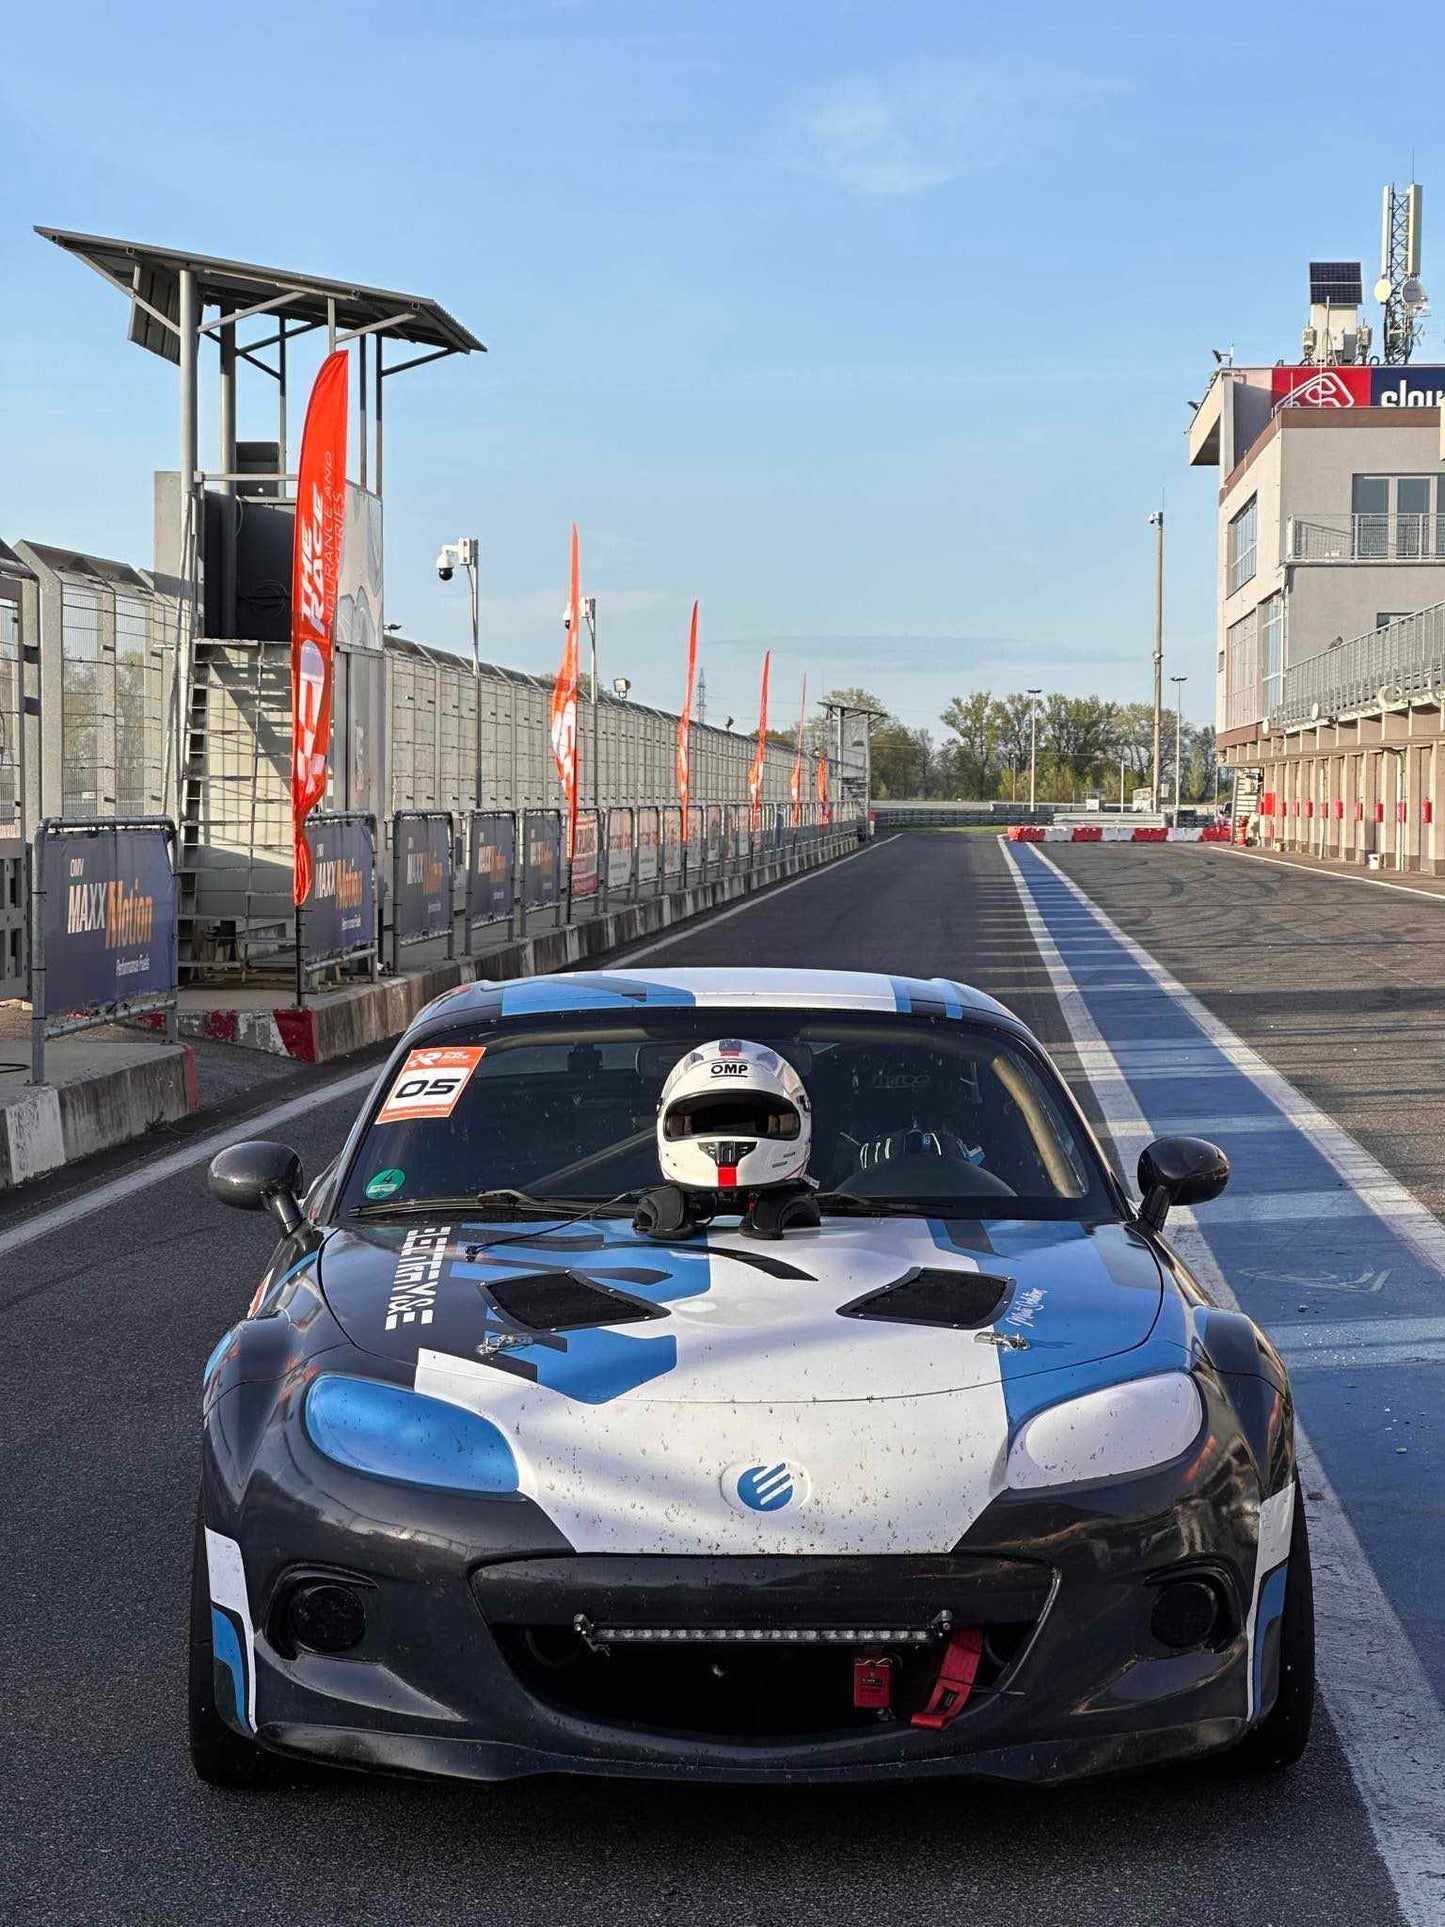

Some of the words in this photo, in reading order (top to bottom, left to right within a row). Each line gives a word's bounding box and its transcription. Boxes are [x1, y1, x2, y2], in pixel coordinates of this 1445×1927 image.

[324, 451, 334, 500] AND
[301, 515, 313, 622] THE
[309, 480, 325, 637] RACE
[710, 1064, 748, 1074] OMP
[395, 1078, 461, 1099] 05
[383, 1170, 395, 1183] 4
